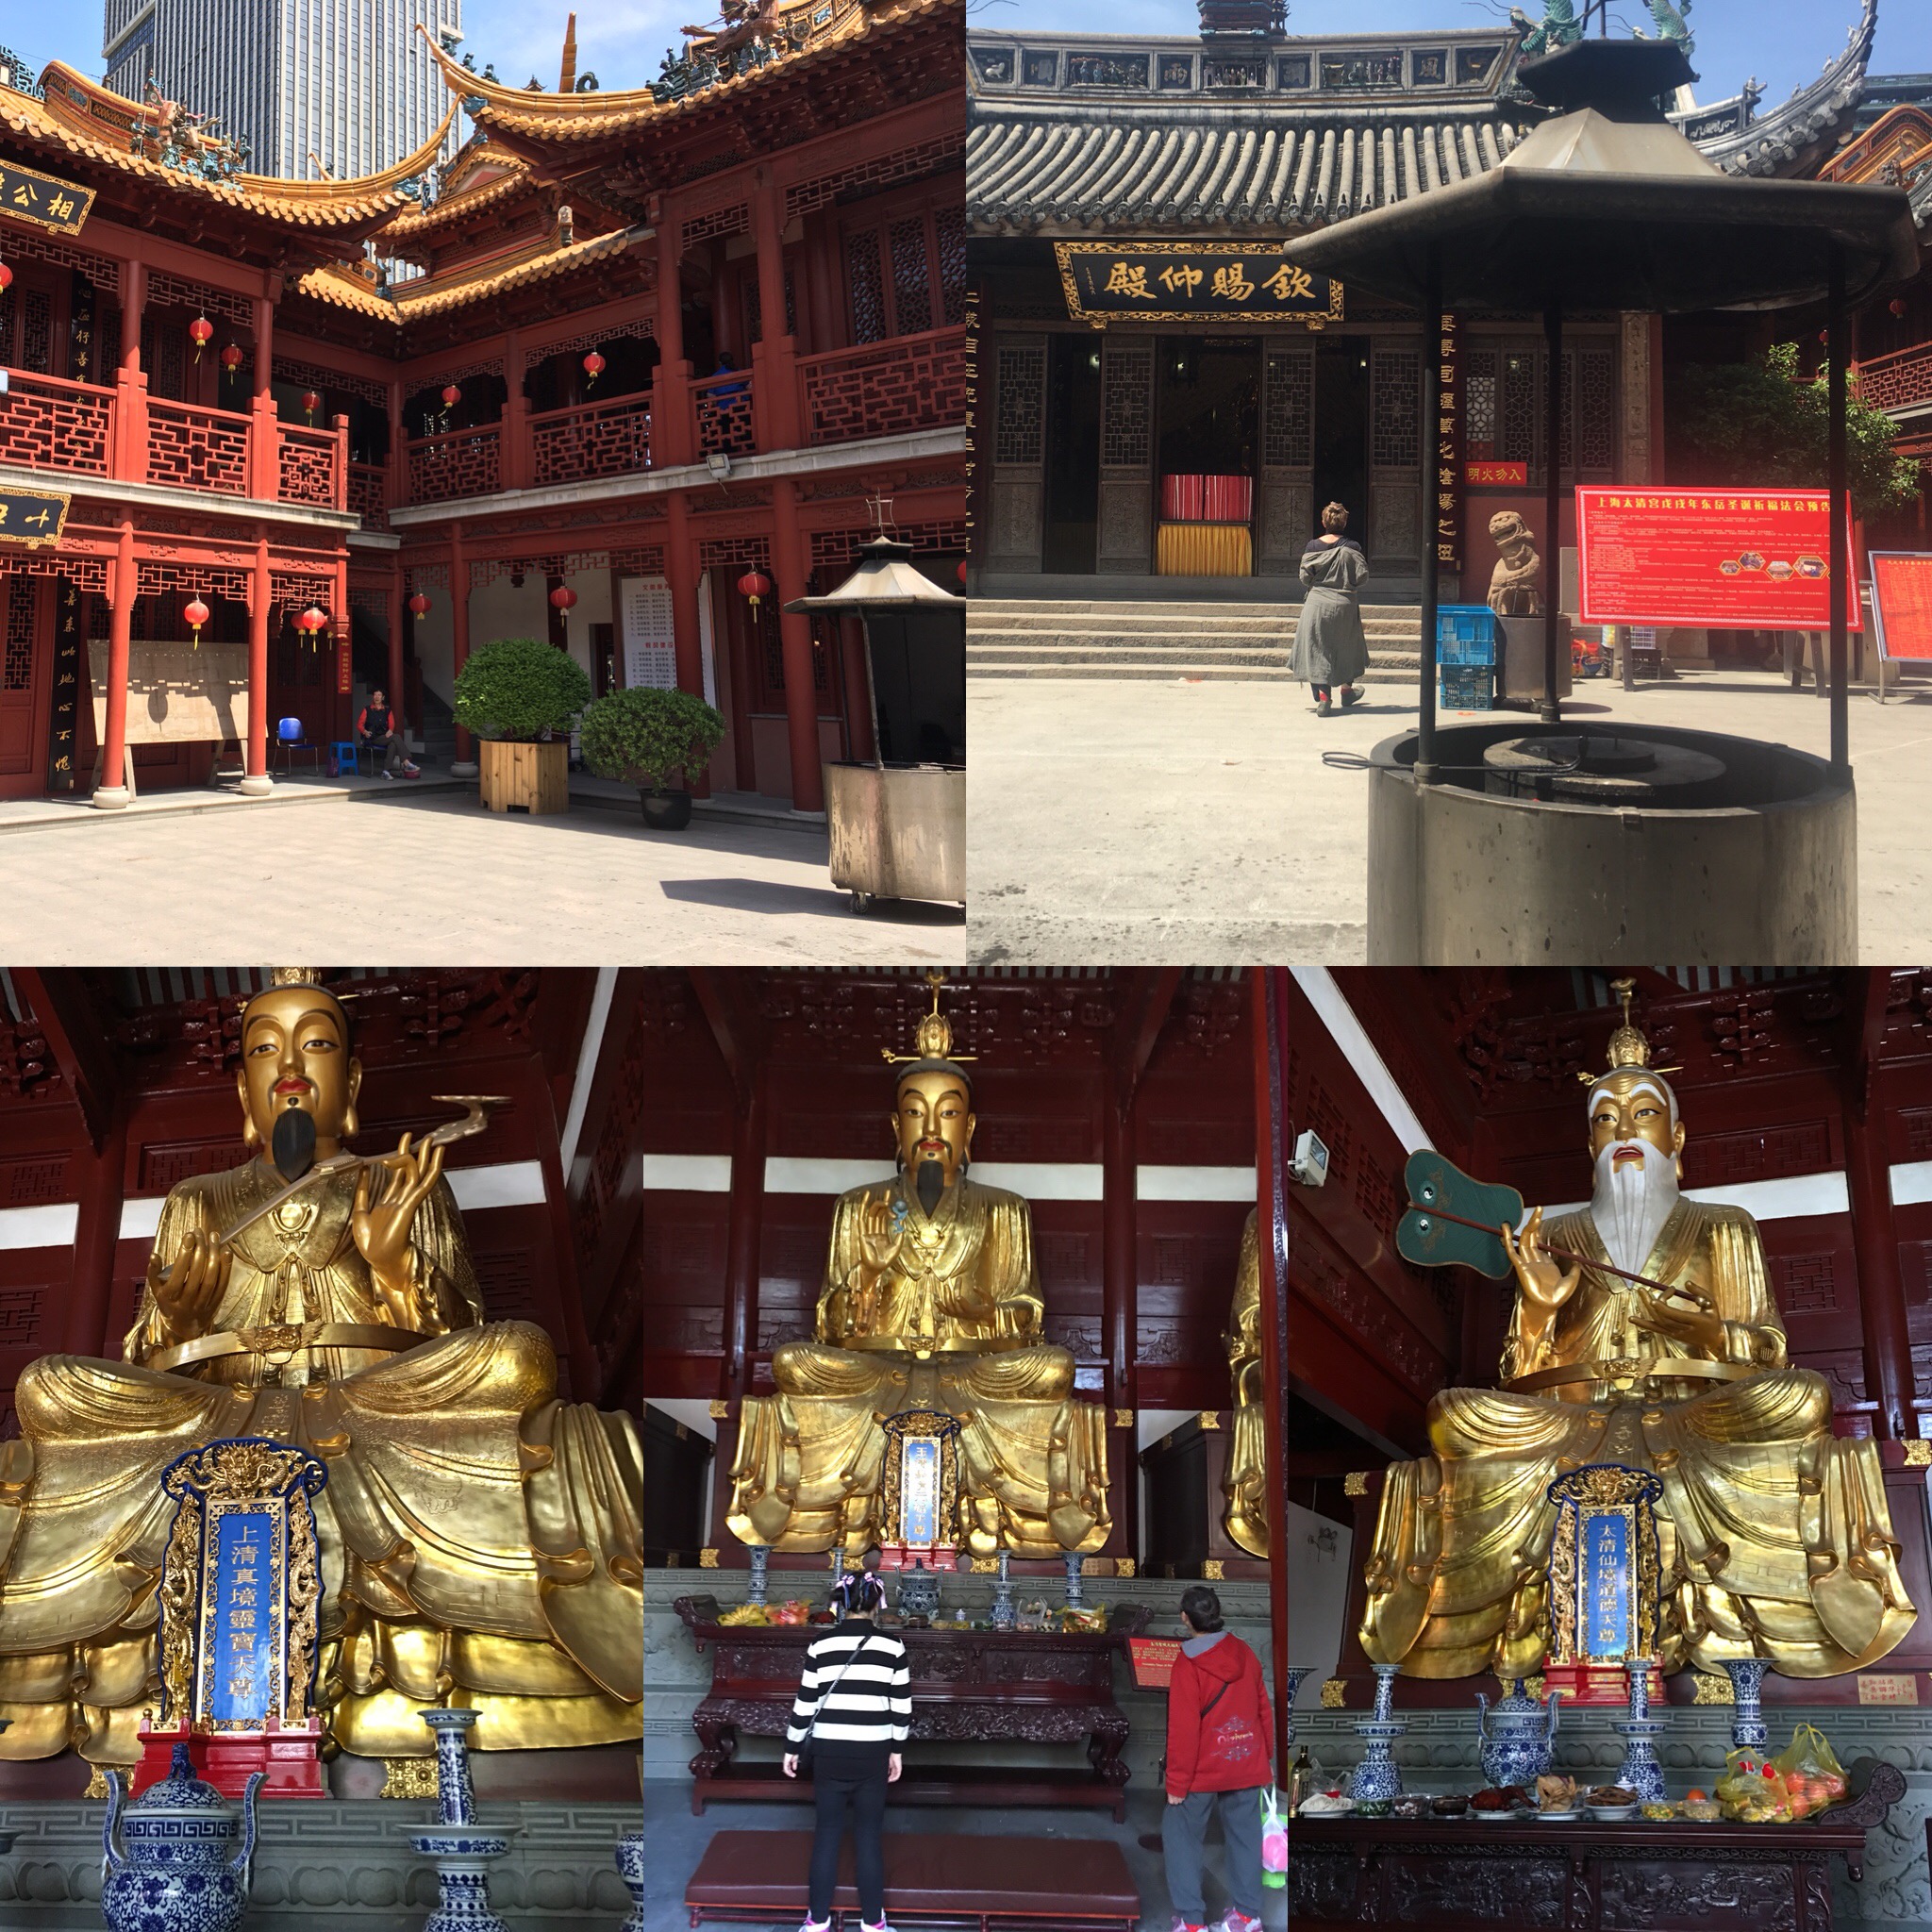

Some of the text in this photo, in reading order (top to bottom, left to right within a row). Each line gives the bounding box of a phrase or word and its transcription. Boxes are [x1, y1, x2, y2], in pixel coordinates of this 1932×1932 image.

[1468, 467, 1522, 481] 明火勿入
[225, 1524, 260, 1700] 上清真境靈寶天尊
